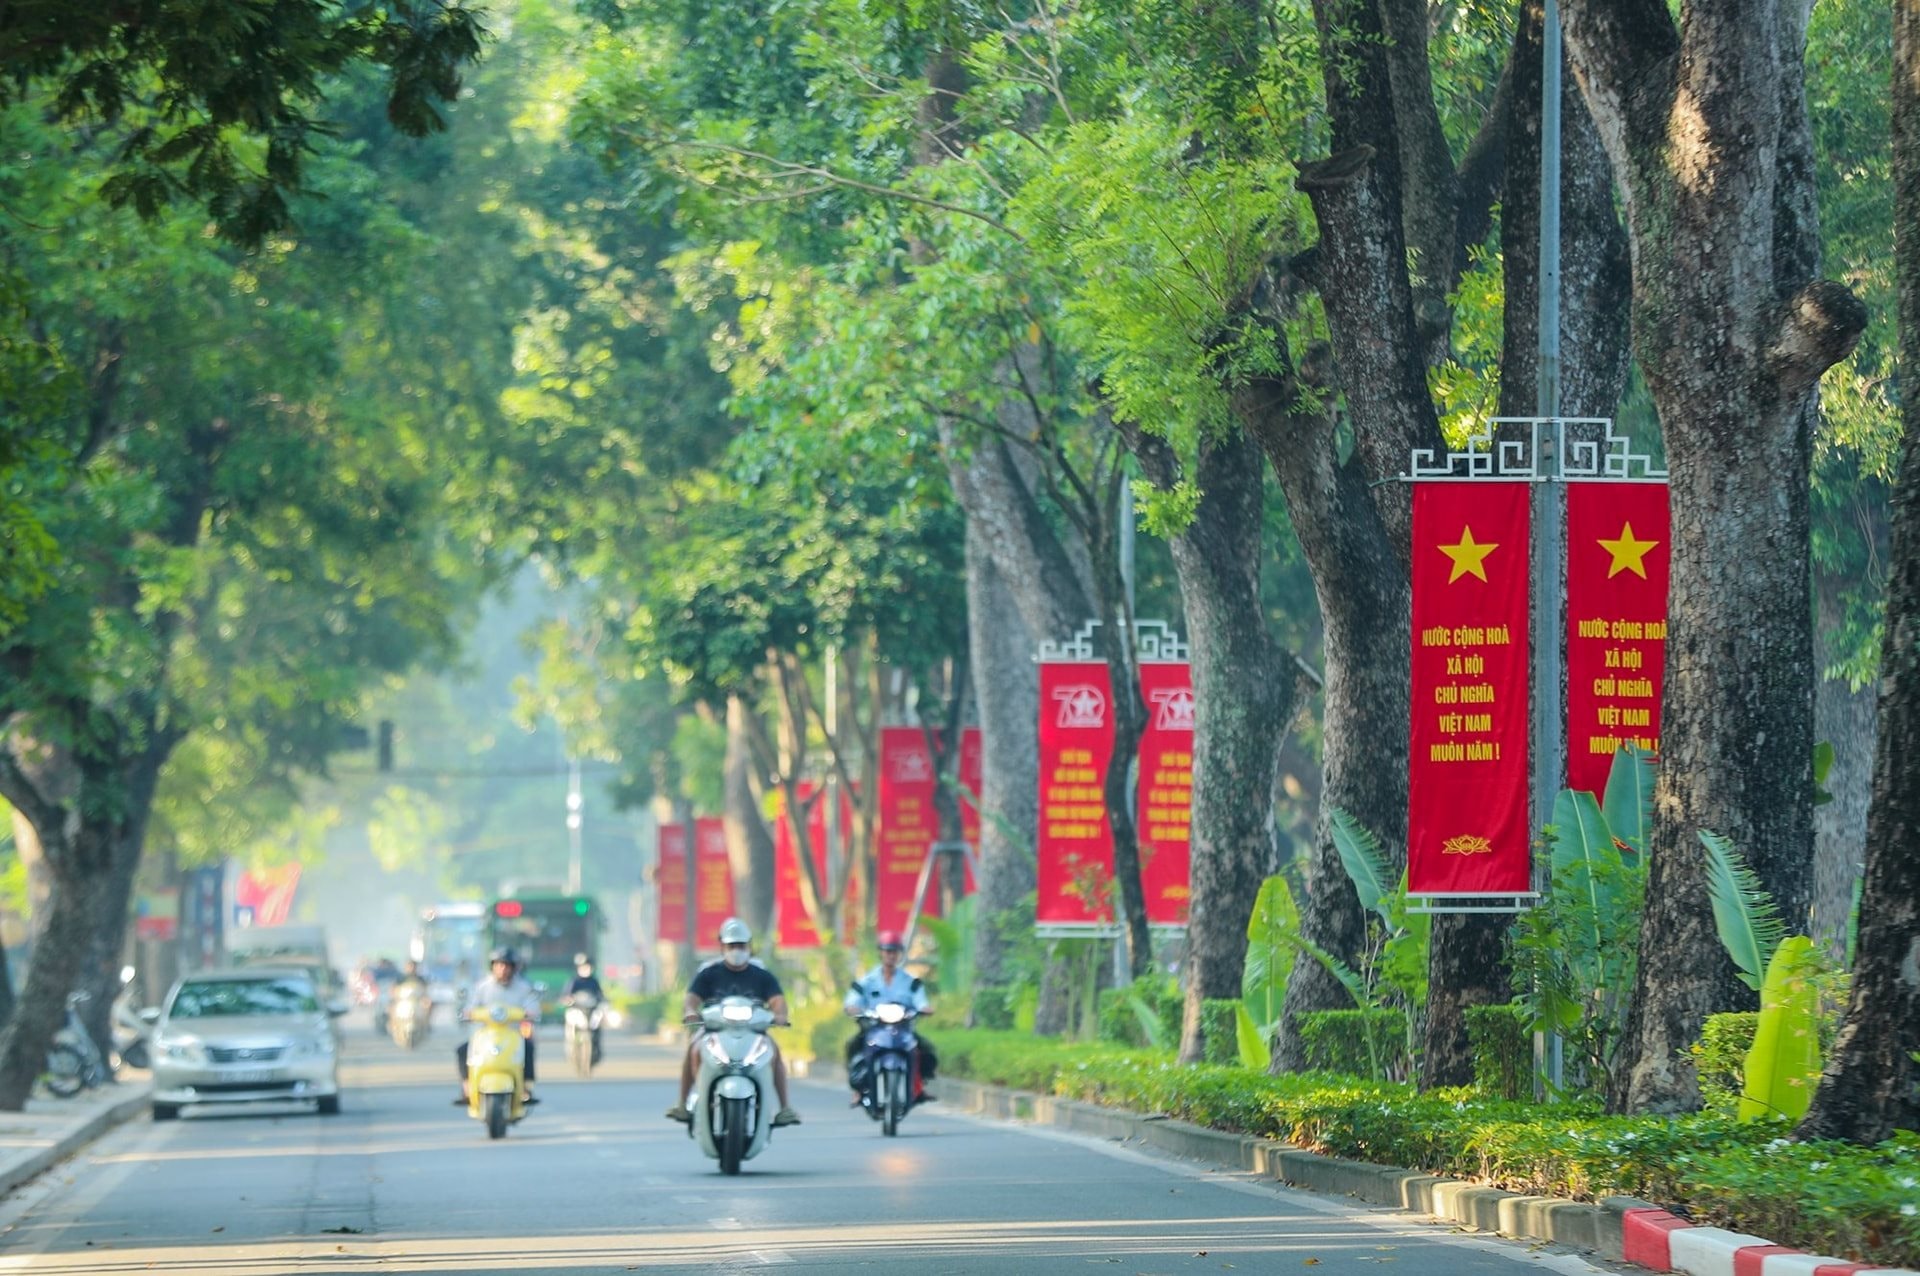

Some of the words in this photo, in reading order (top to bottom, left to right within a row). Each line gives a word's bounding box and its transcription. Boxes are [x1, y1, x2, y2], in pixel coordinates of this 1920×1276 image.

[1422, 625, 1451, 647] NƯỚC
[1454, 624, 1484, 649] CỘNG
[1486, 623, 1510, 645] HOÀ
[1579, 617, 1609, 638] NƯỚC
[1612, 618, 1643, 643] CỘNG
[1645, 619, 1668, 640] HOÀ
[1447, 654, 1462, 675] XÃ
[1465, 653, 1484, 678] HỘI
[1605, 647, 1620, 668] XÃ
[1622, 647, 1642, 672] HỘI
[1435, 681, 1457, 704] CHỦ
[1460, 682, 1494, 703] NGHĨA
[1594, 673, 1615, 696] CHỦ
[1618, 677, 1653, 697] NGHĨA
[1439, 711, 1463, 736] VIỆT
[1465, 714, 1491, 732] NAM
[1598, 704, 1620, 729] VIỆT
[1623, 708, 1650, 727] NAM
[1431, 740, 1464, 762] MUÔN
[1467, 740, 1493, 761] NĂM
